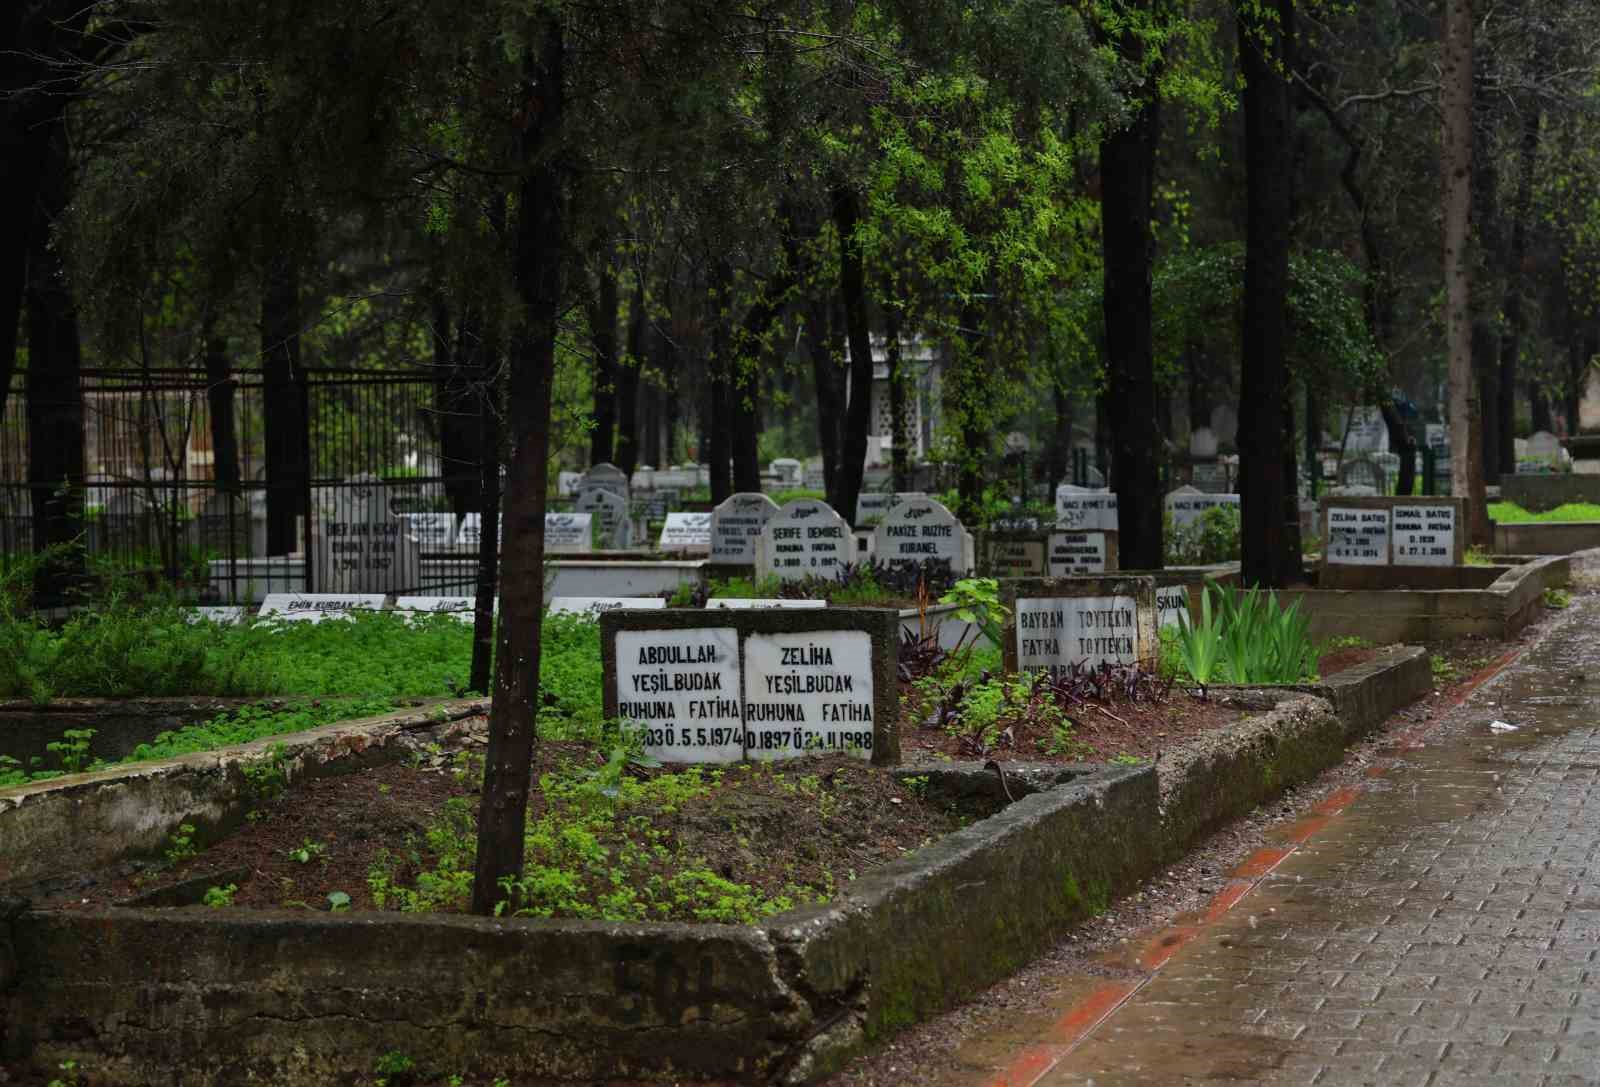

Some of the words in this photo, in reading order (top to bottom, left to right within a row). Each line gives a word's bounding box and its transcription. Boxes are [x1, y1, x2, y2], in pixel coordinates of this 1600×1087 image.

[1157, 595, 1185, 612] ŞKUN
[638, 645, 717, 664] ABDULLAH
[781, 643, 833, 666] ZELİHA
[632, 668, 722, 695] YEŞİLBUDAK
[765, 669, 853, 695] YEŞİLBUDAK
[619, 701, 676, 719] RUHUNA
[689, 695, 740, 719] FATİHA
[747, 703, 805, 722] RUHUNA
[822, 699, 873, 722] FATİHA
